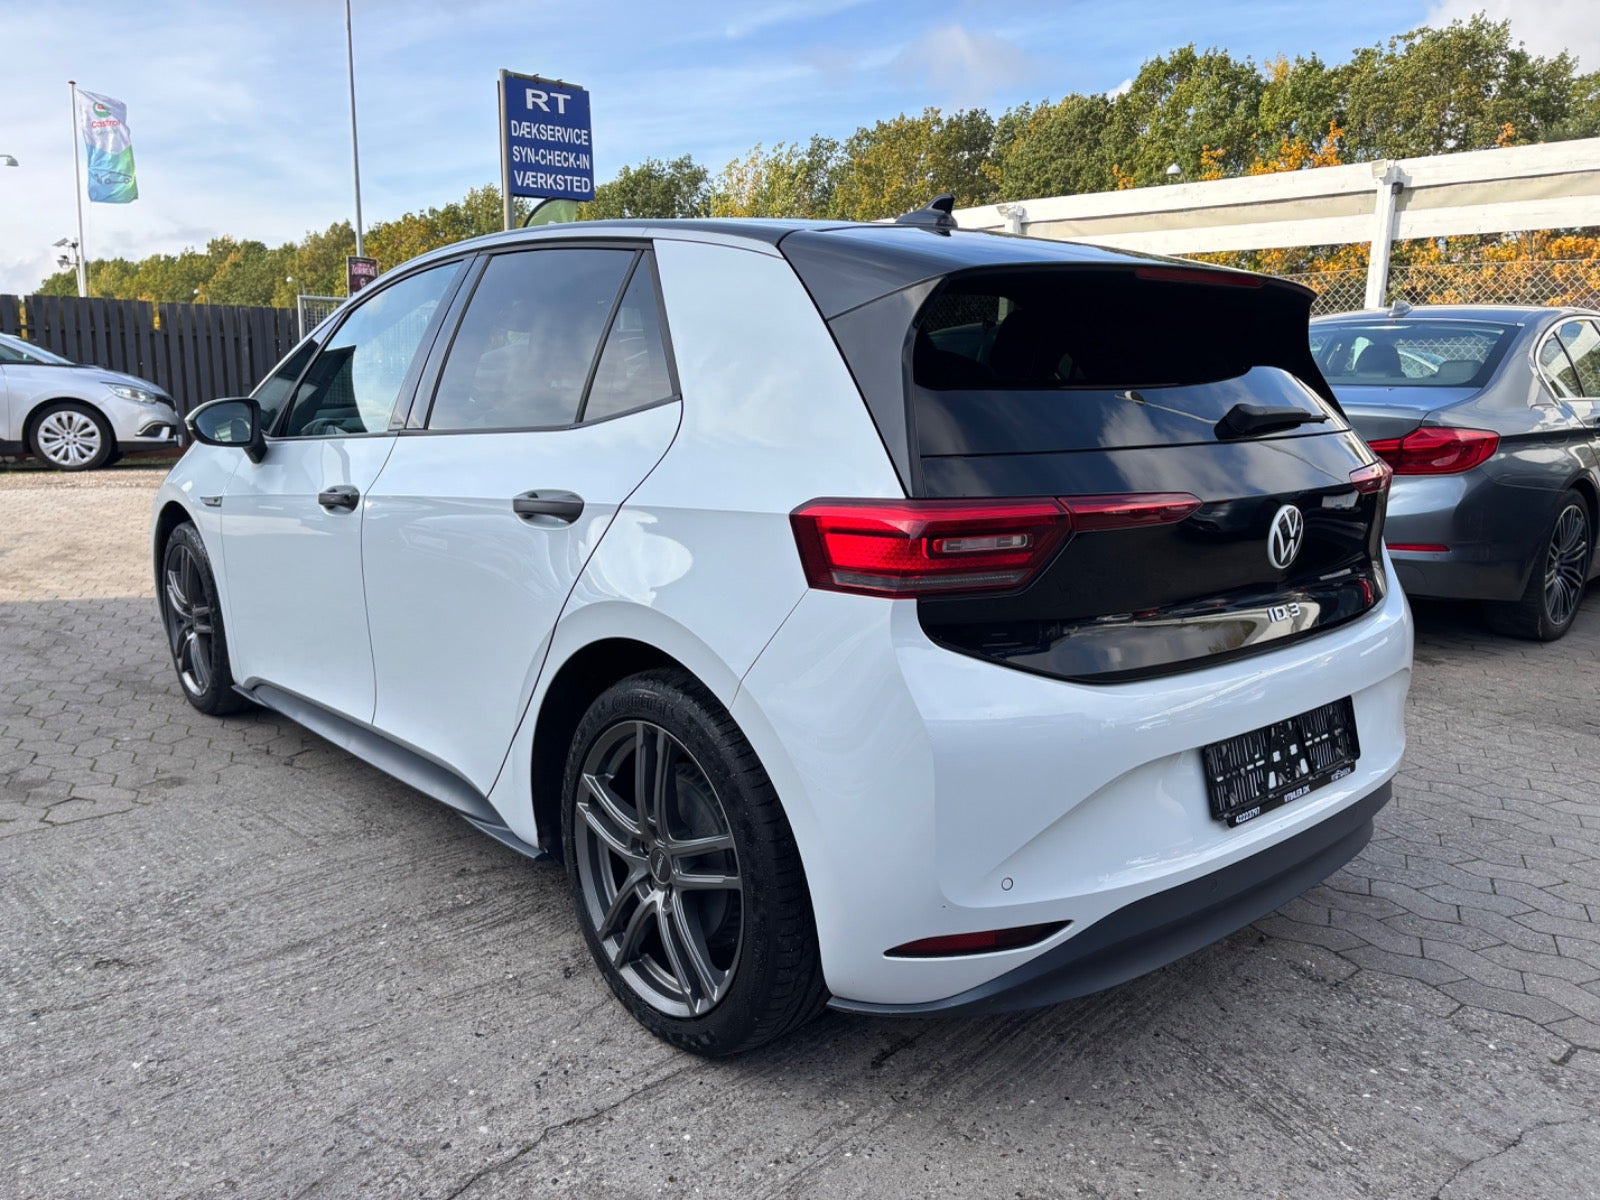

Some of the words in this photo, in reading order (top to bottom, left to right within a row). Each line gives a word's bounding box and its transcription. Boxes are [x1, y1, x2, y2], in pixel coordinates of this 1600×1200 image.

[525, 88, 571, 114] RT
[92, 120, 120, 129] Castrol
[511, 120, 589, 145] DÆKSERVICE
[512, 146, 590, 170] SYN-CHECK-IN
[514, 170, 591, 193] VÆRKSTED
